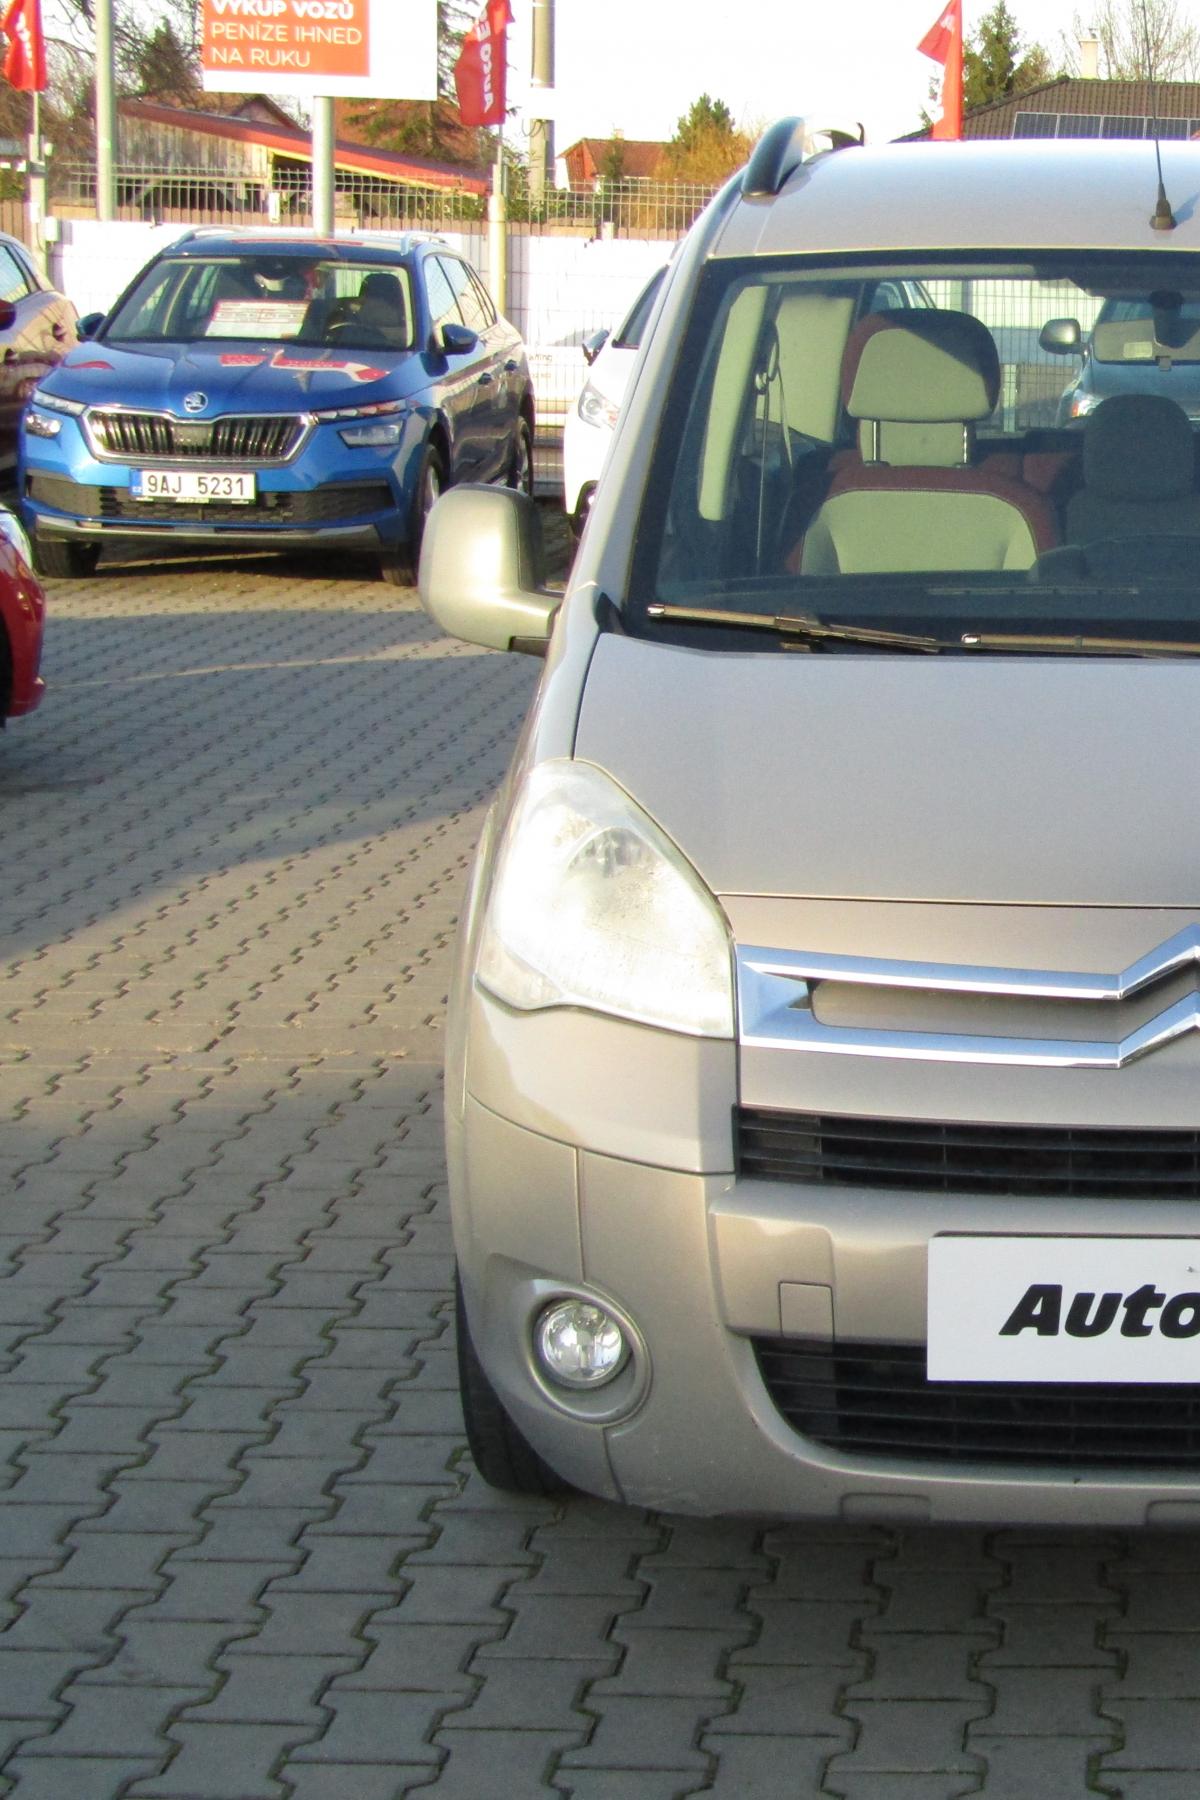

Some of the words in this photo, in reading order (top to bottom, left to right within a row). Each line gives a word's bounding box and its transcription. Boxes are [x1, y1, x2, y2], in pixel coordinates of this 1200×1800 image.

[211, 21, 289, 42] PENÍZE
[295, 26, 363, 45] IHNED
[211, 48, 244, 64] NA
[251, 48, 311, 67] RUKU
[147, 475, 182, 494] 9AJ
[198, 476, 244, 496] 5231
